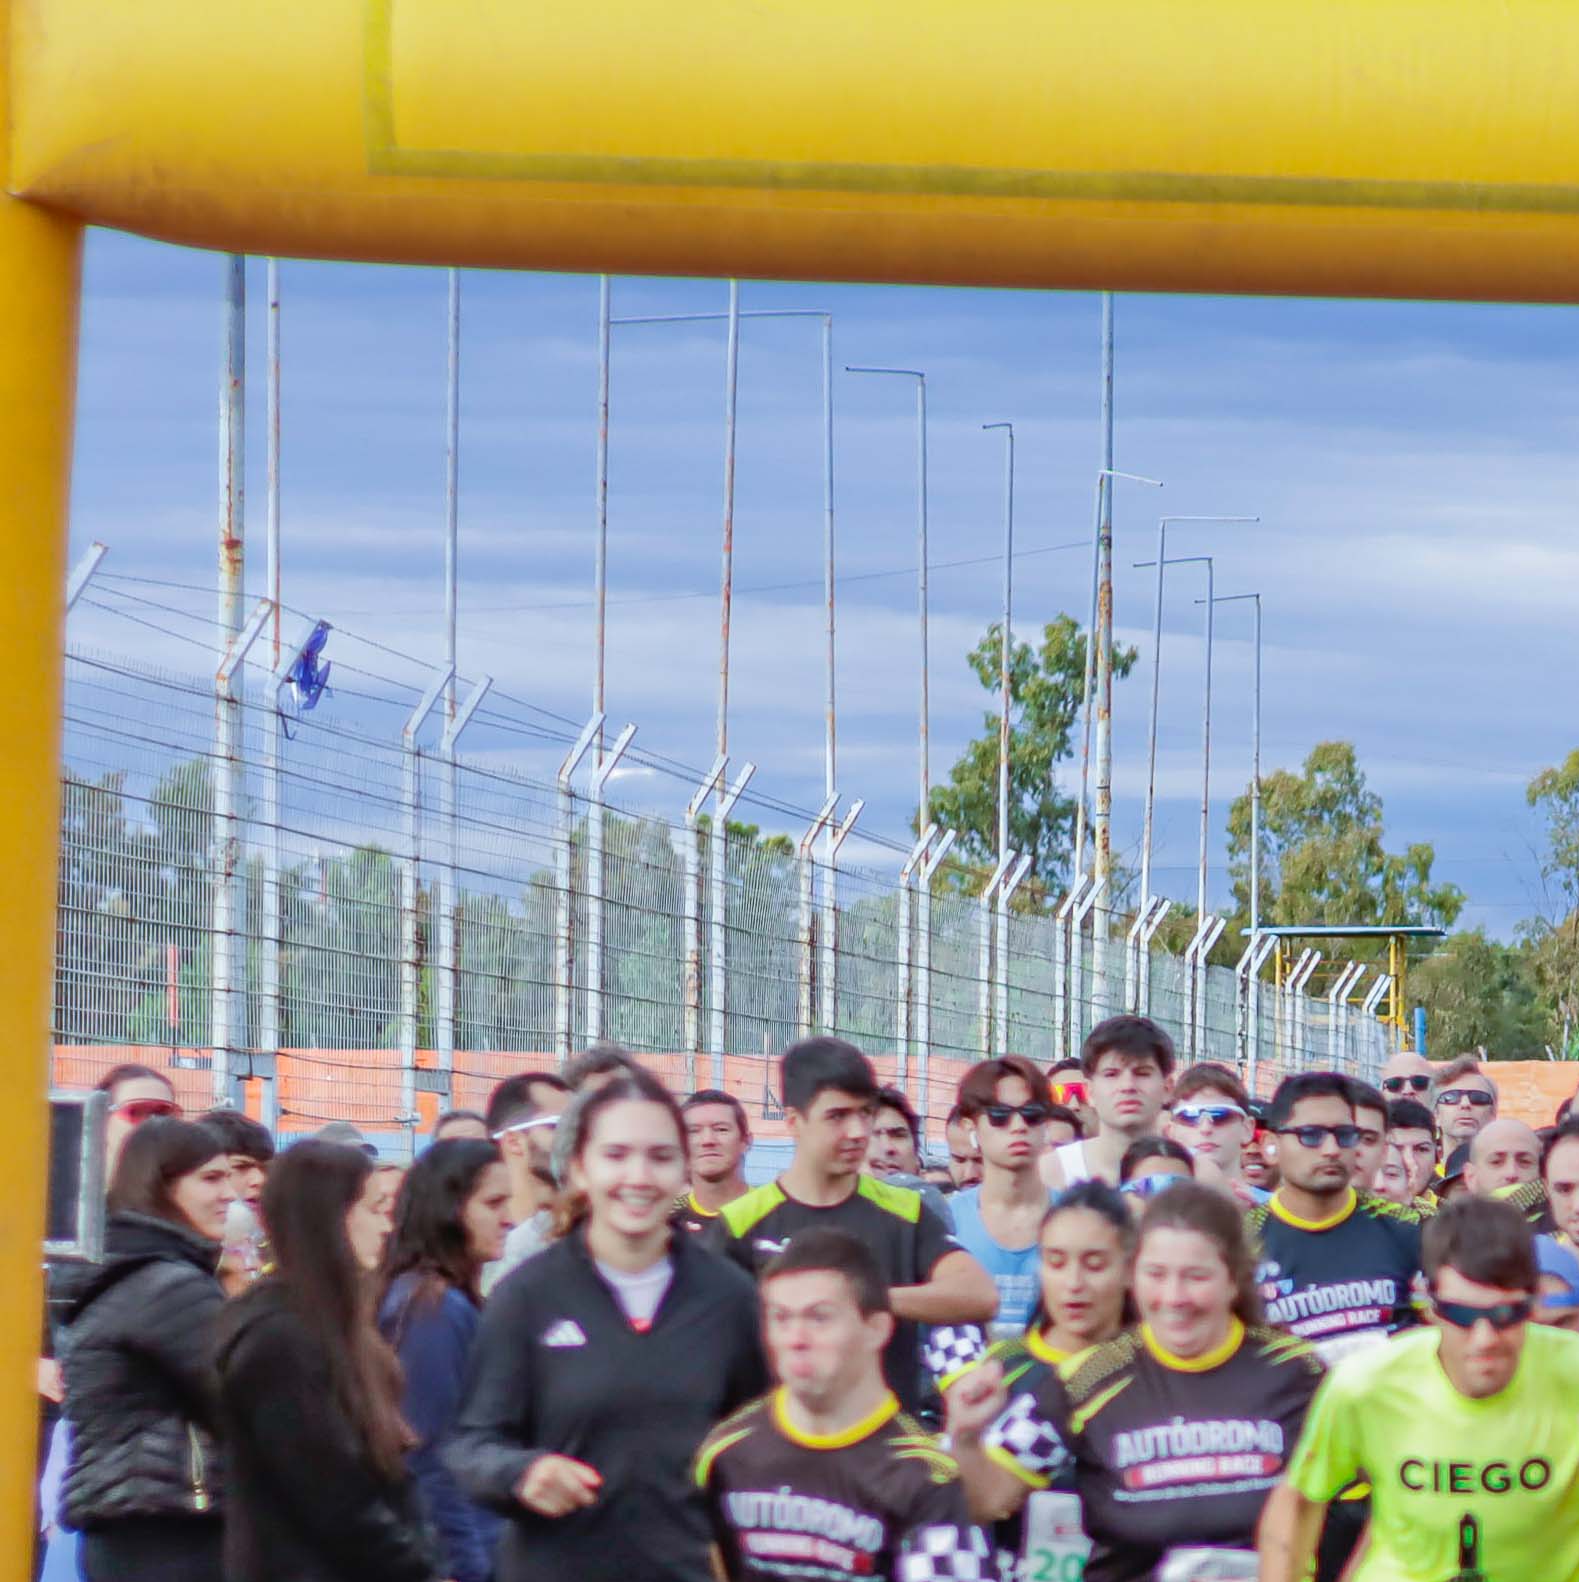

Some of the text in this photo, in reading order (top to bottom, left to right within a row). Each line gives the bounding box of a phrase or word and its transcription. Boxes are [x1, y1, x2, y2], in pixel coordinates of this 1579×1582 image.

[1266, 1279, 1396, 1323] AUTÓDROMO
[1116, 1416, 1284, 1468] AUTÓDROMO
[1399, 1458, 1551, 1494] CIEGO
